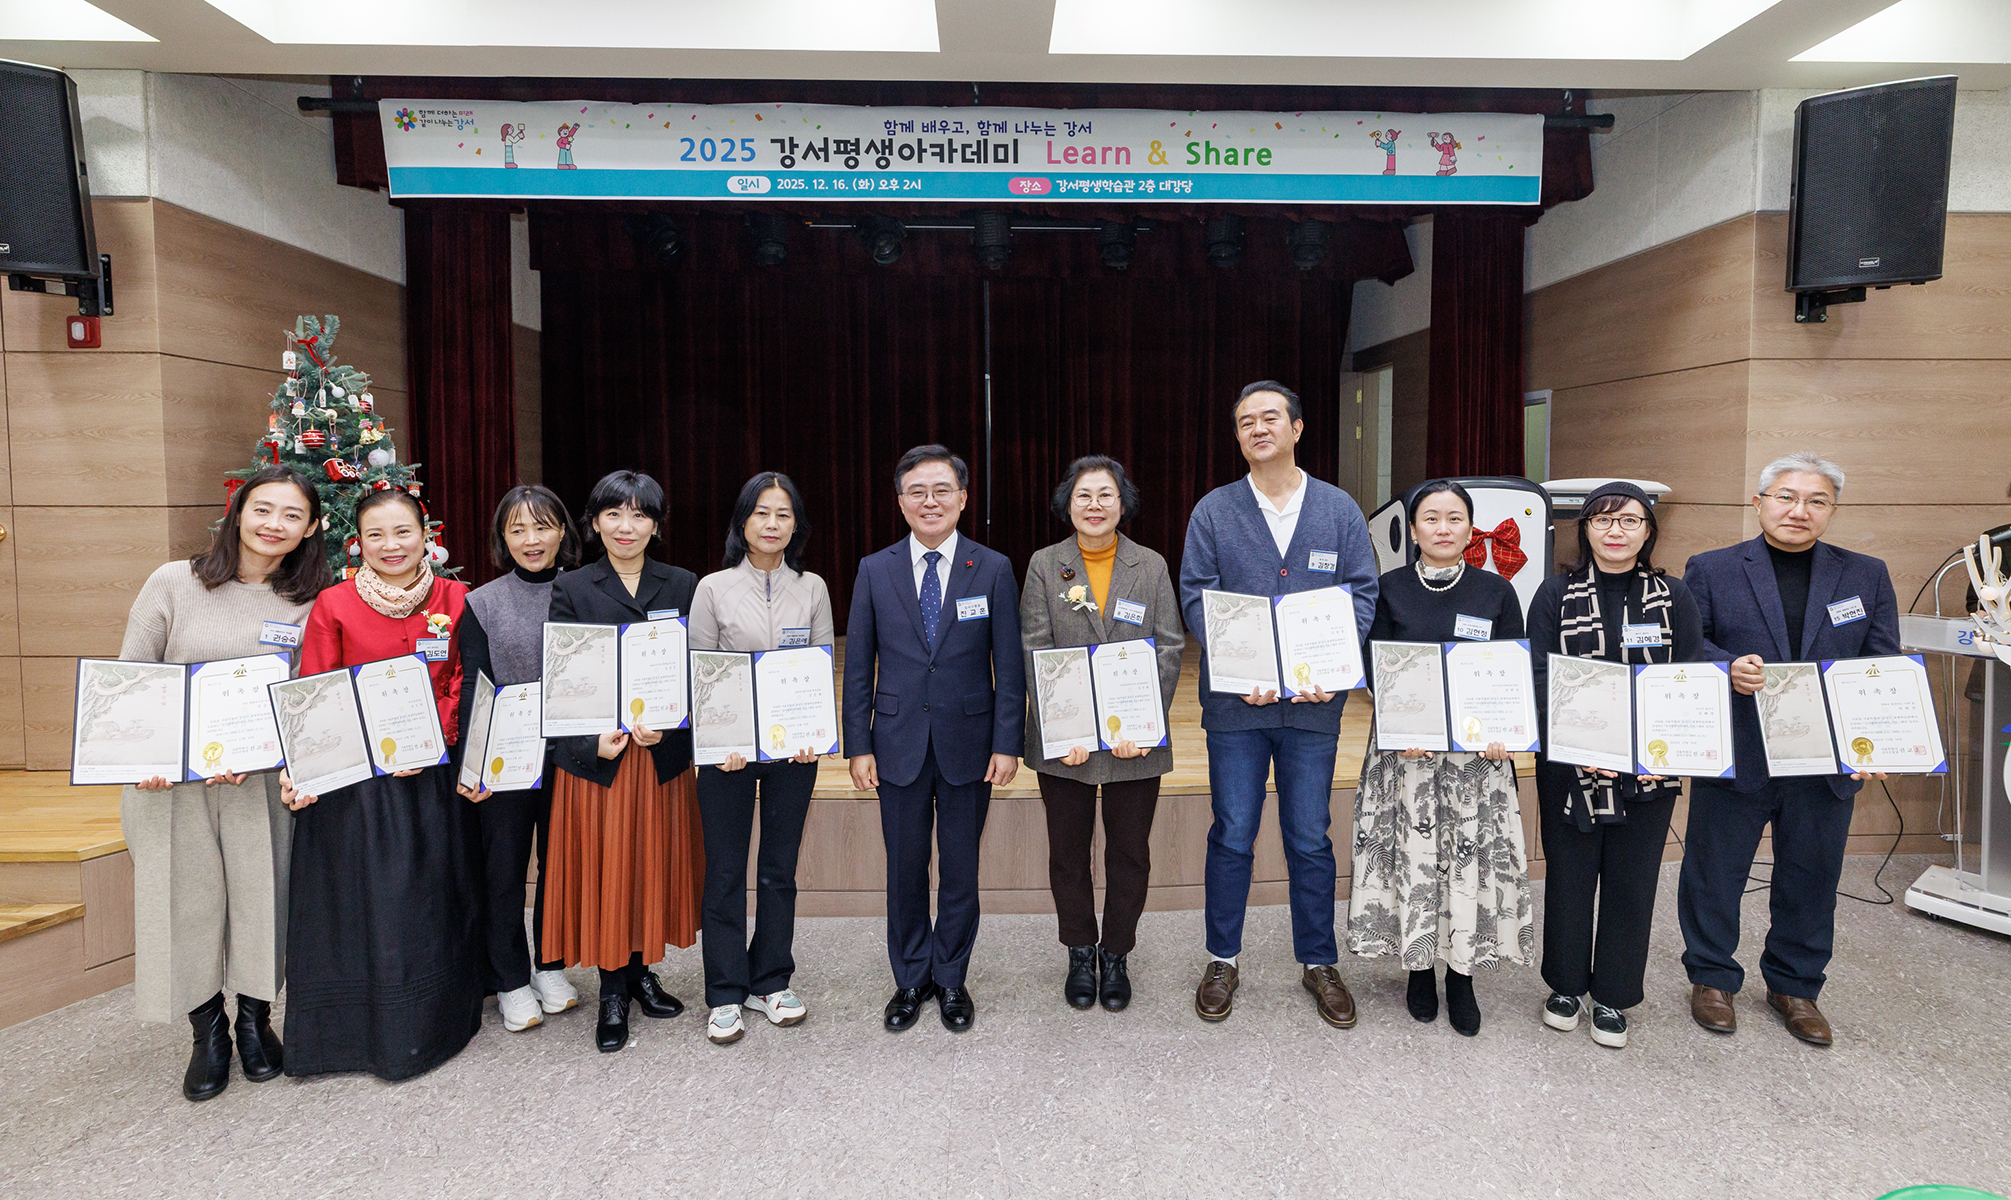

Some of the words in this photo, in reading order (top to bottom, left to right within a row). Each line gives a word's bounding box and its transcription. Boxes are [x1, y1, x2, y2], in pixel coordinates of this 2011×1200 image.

[418, 109, 435, 118] 함께
[436, 110, 458, 118] 더하는
[434, 119, 453, 127] 나누는
[454, 118, 474, 131] 강서
[884, 119, 914, 136] 함께
[921, 119, 969, 136] 배우고,
[977, 121, 1007, 136] 함께
[1015, 121, 1056, 137] 나누는
[1063, 121, 1092, 137] 강서
[680, 137, 756, 163] 2025
[770, 136, 1019, 170] 강서평생아카데미
[1047, 140, 1131, 166] Learn
[1147, 140, 1169, 166] &
[1186, 140, 1272, 166] Share
[736, 178, 760, 191] 일시
[777, 178, 809, 190] 2025.
[812, 179, 829, 190] 12.
[832, 179, 849, 190] 16.
[852, 178, 875, 192] (화)
[878, 179, 900, 191] 오후
[903, 178, 921, 191] 2시
[1019, 180, 1042, 193] 장소
[1056, 180, 1135, 193] 강서평생학습관
[1138, 180, 1156, 193] 2층
[1159, 180, 1193, 193] 대강당
